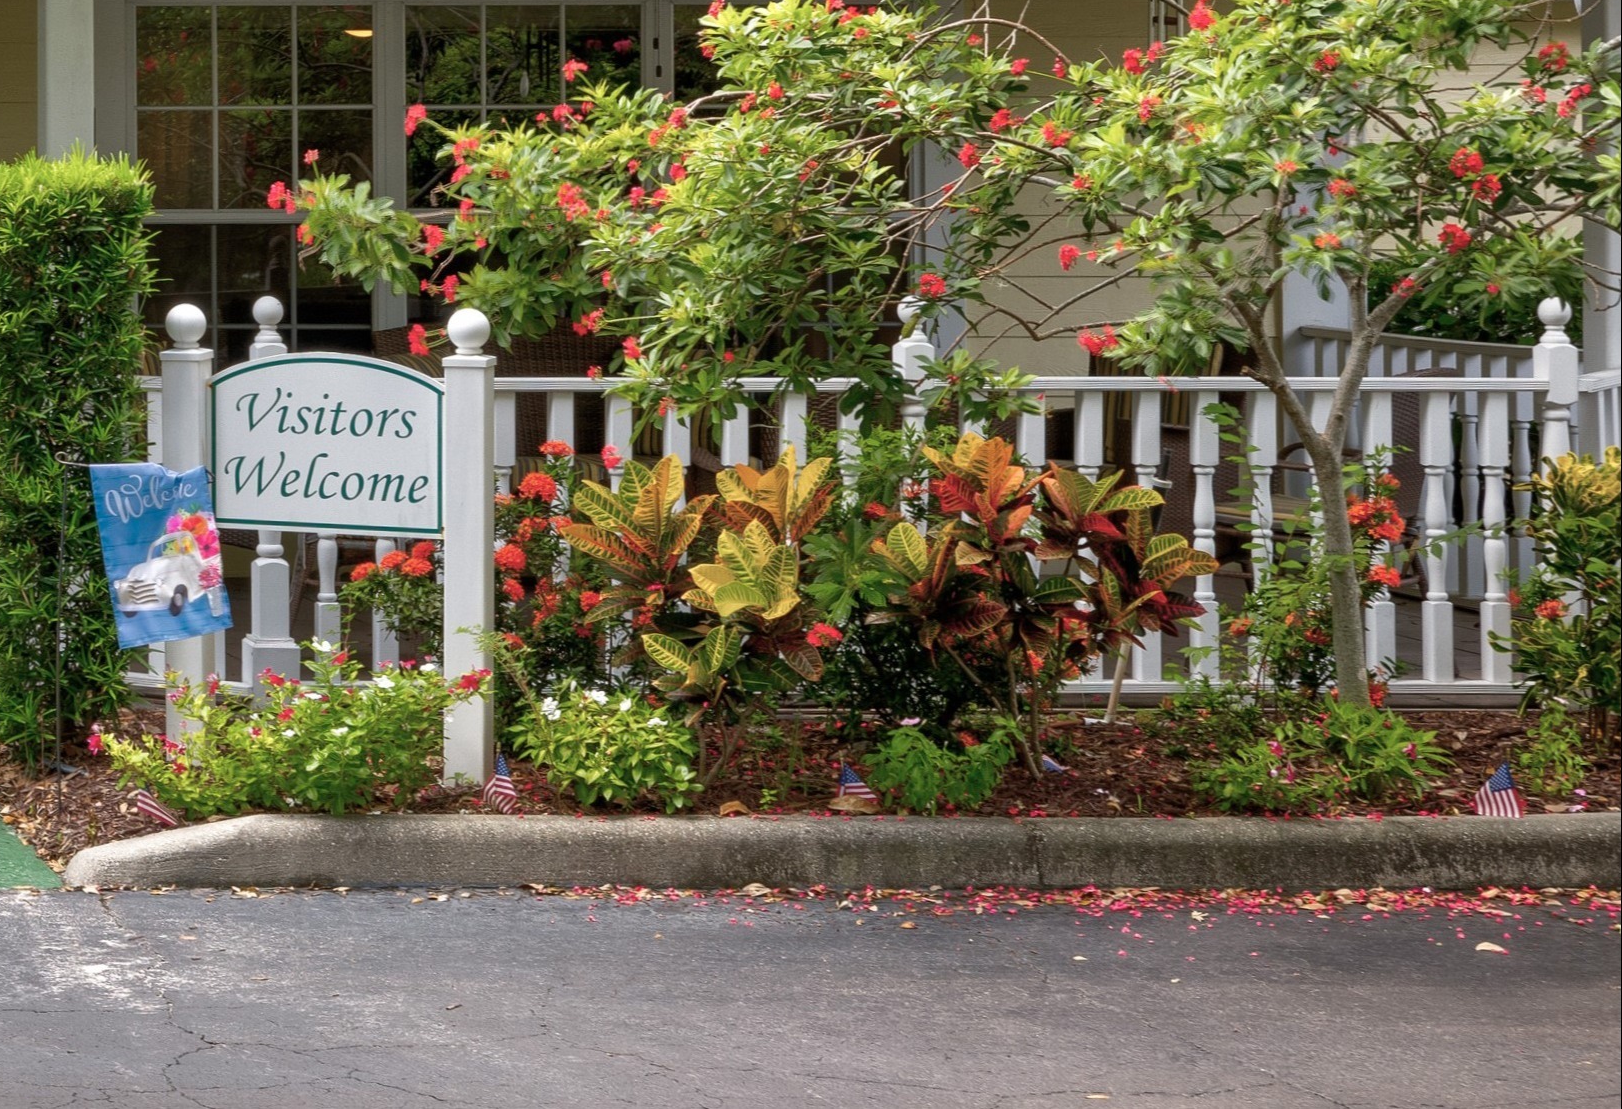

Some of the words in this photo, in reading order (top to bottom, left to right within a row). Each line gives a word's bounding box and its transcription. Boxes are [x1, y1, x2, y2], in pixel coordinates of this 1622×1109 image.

[235, 387, 417, 439] Visitors
[104, 474, 198, 524] Welce
[224, 451, 430, 504] Welcome
